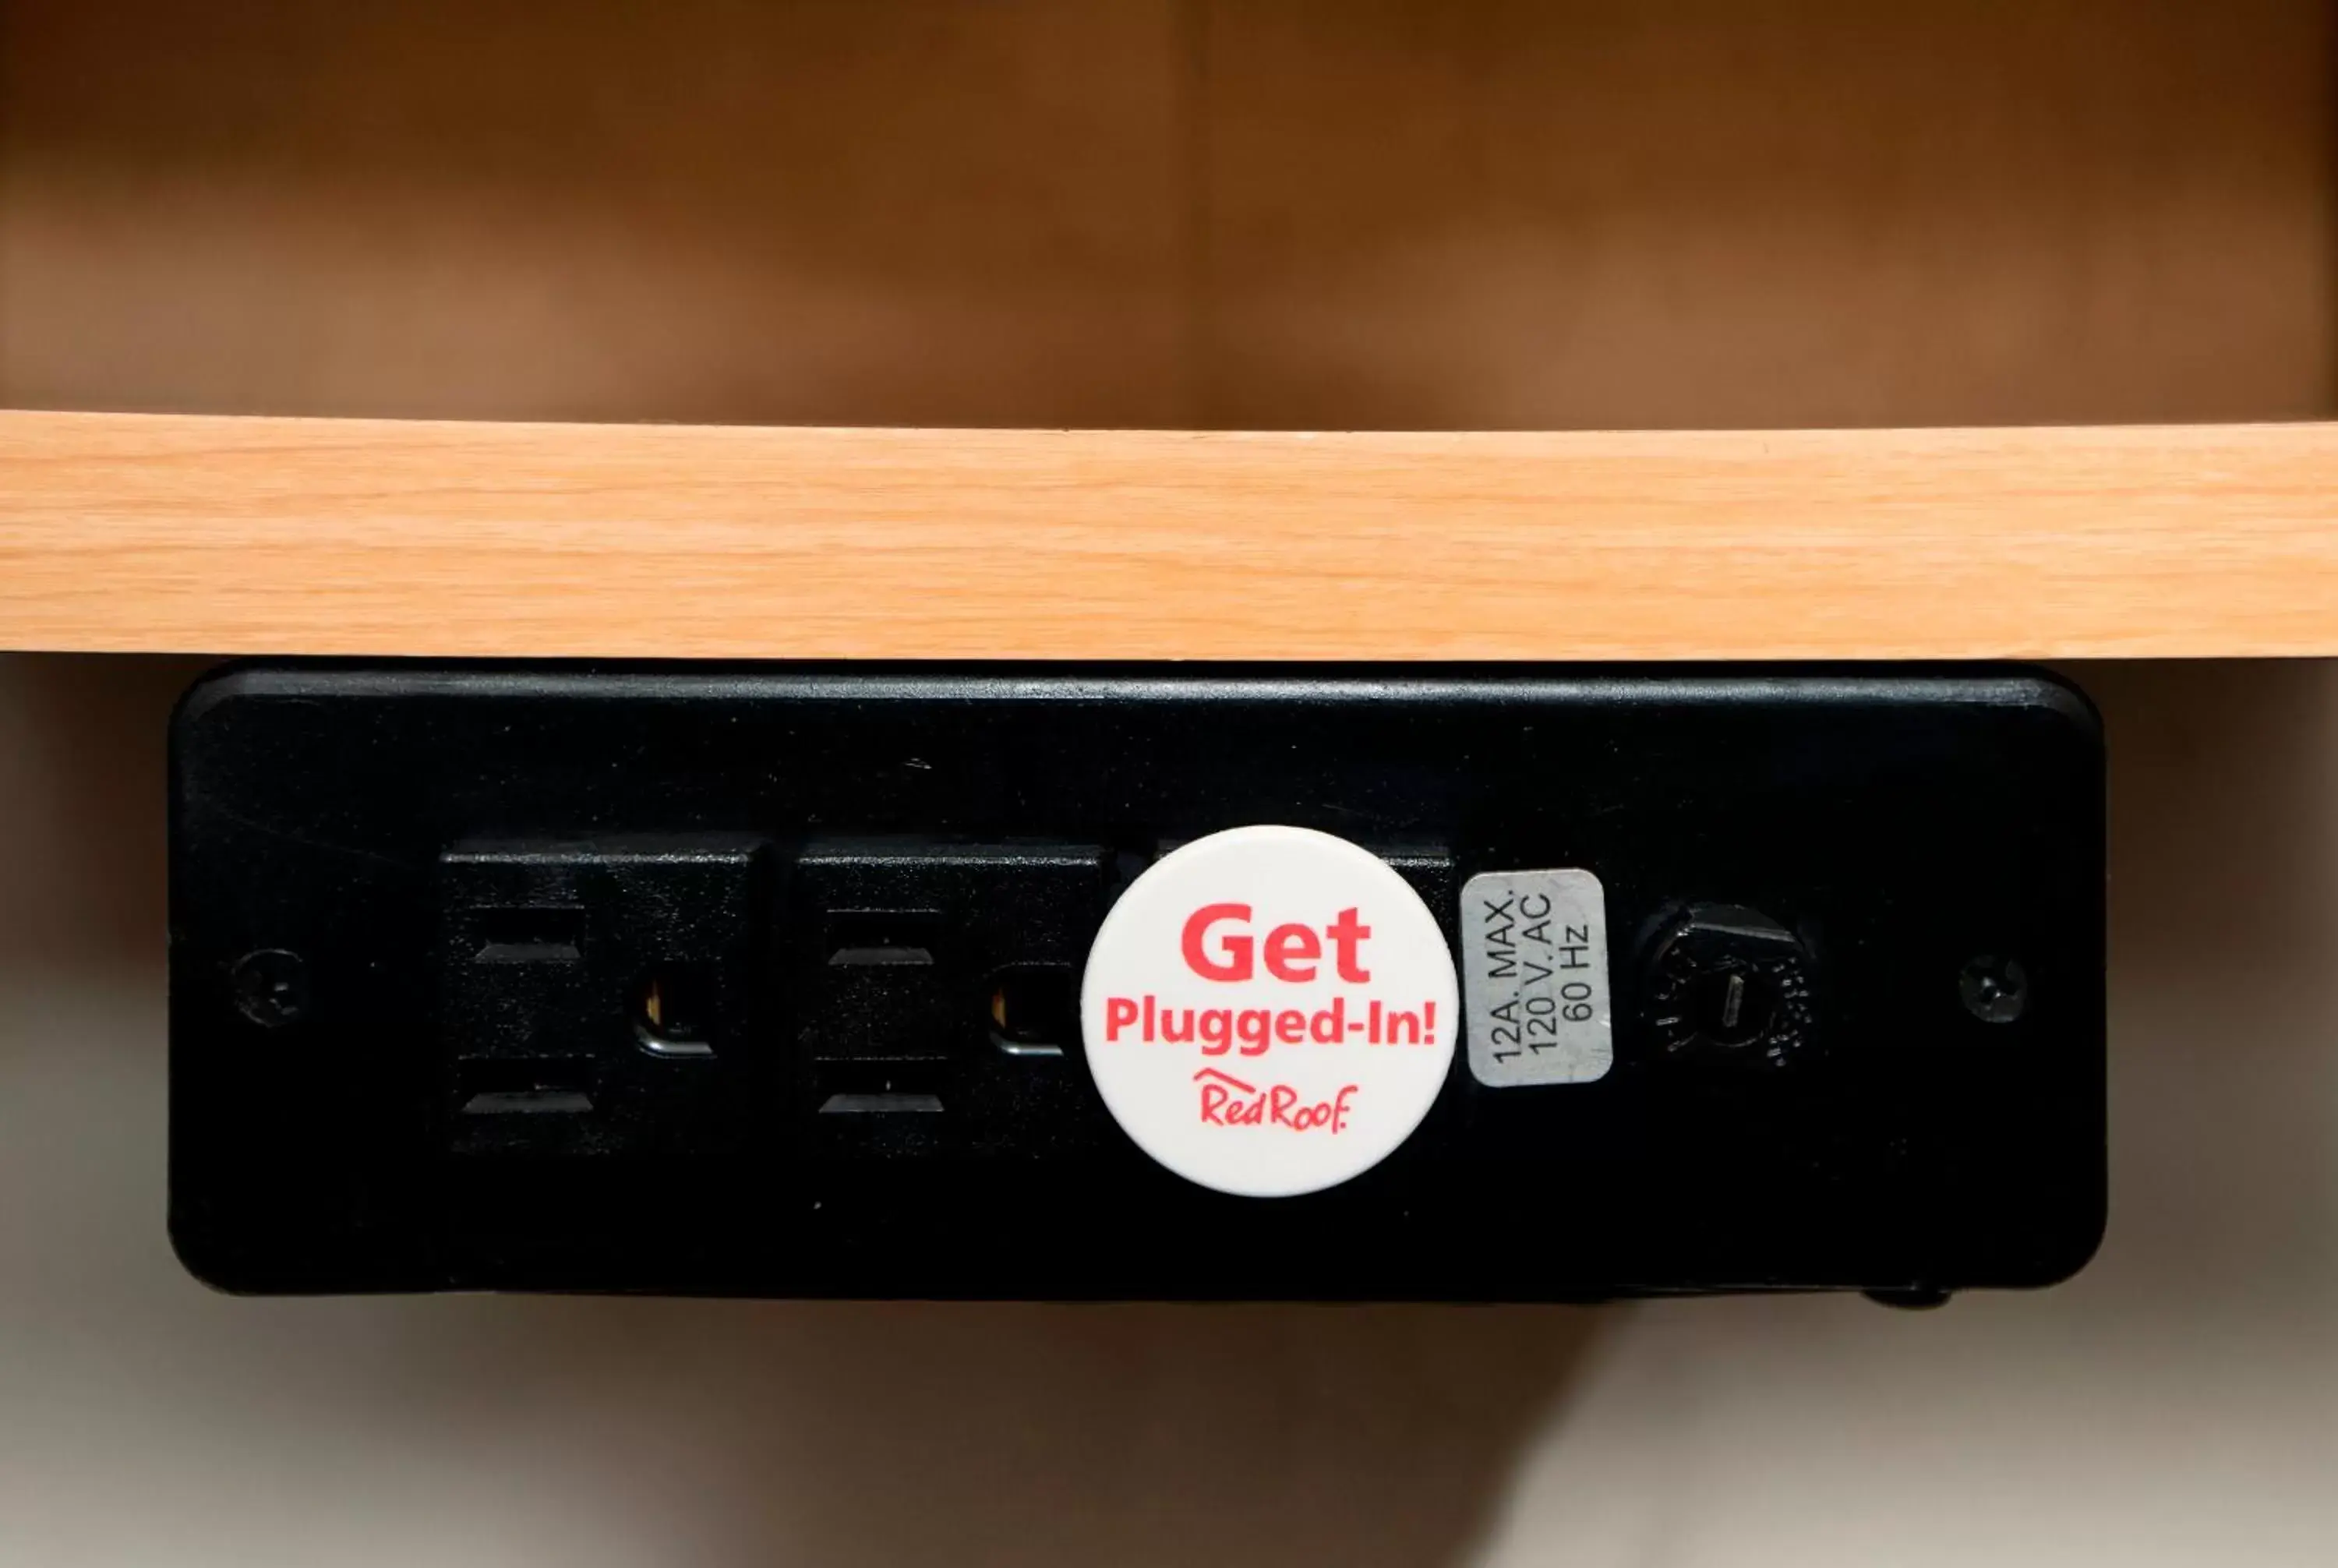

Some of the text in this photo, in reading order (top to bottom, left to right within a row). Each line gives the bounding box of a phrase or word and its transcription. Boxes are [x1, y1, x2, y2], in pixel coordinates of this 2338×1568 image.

[1180, 902, 1372, 984] Get
[1483, 890, 1522, 1064] 12A. MAX.
[1559, 925, 1593, 1022] 60 Hz
[1105, 994, 1436, 1057] Plugged-In!
[1525, 997, 1558, 1055] 120
